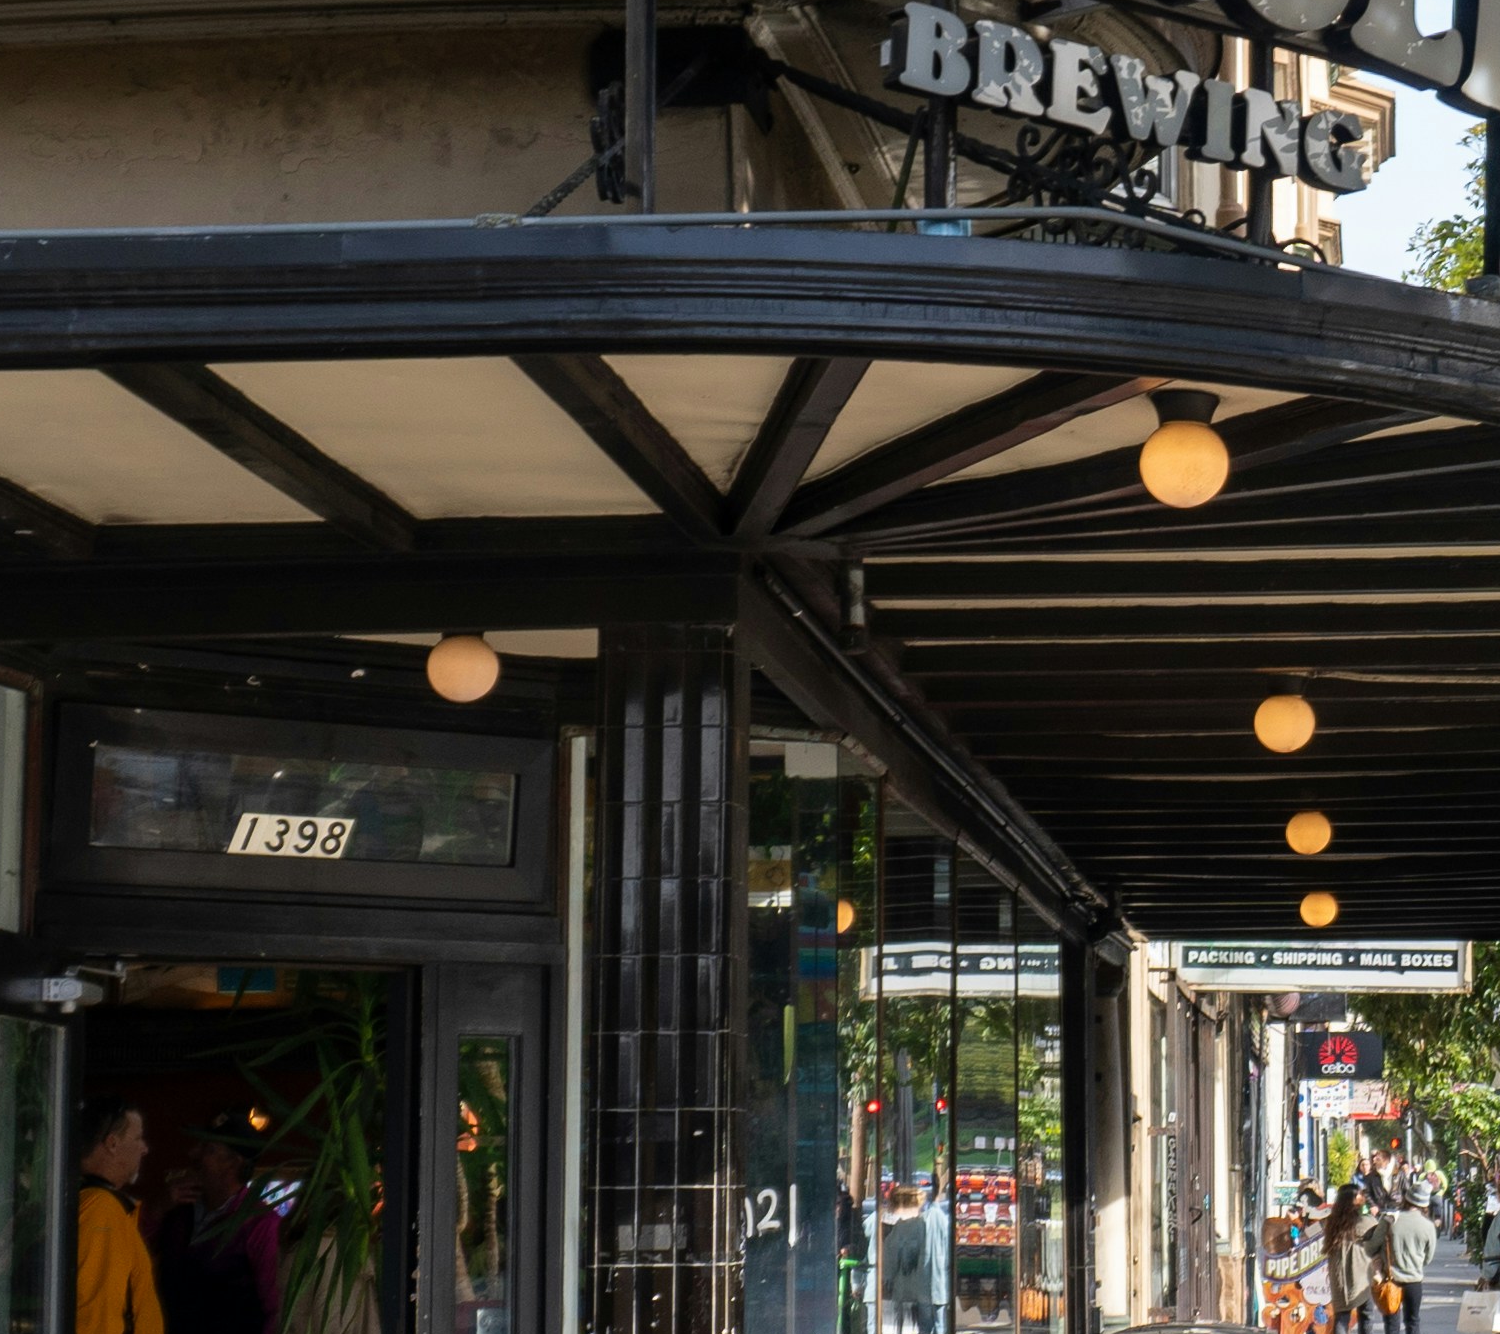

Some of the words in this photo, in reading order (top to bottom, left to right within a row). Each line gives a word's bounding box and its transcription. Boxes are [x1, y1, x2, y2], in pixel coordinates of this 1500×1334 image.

[894, 0, 1370, 195] BREWING
[241, 816, 346, 855] 1398
[1187, 949, 1255, 965] PACKING
[1272, 951, 1343, 966] SHIPPING
[1360, 952, 1397, 967] MAIL
[1400, 953, 1454, 968] BOXES
[1266, 1255, 1298, 1279] PIPE
